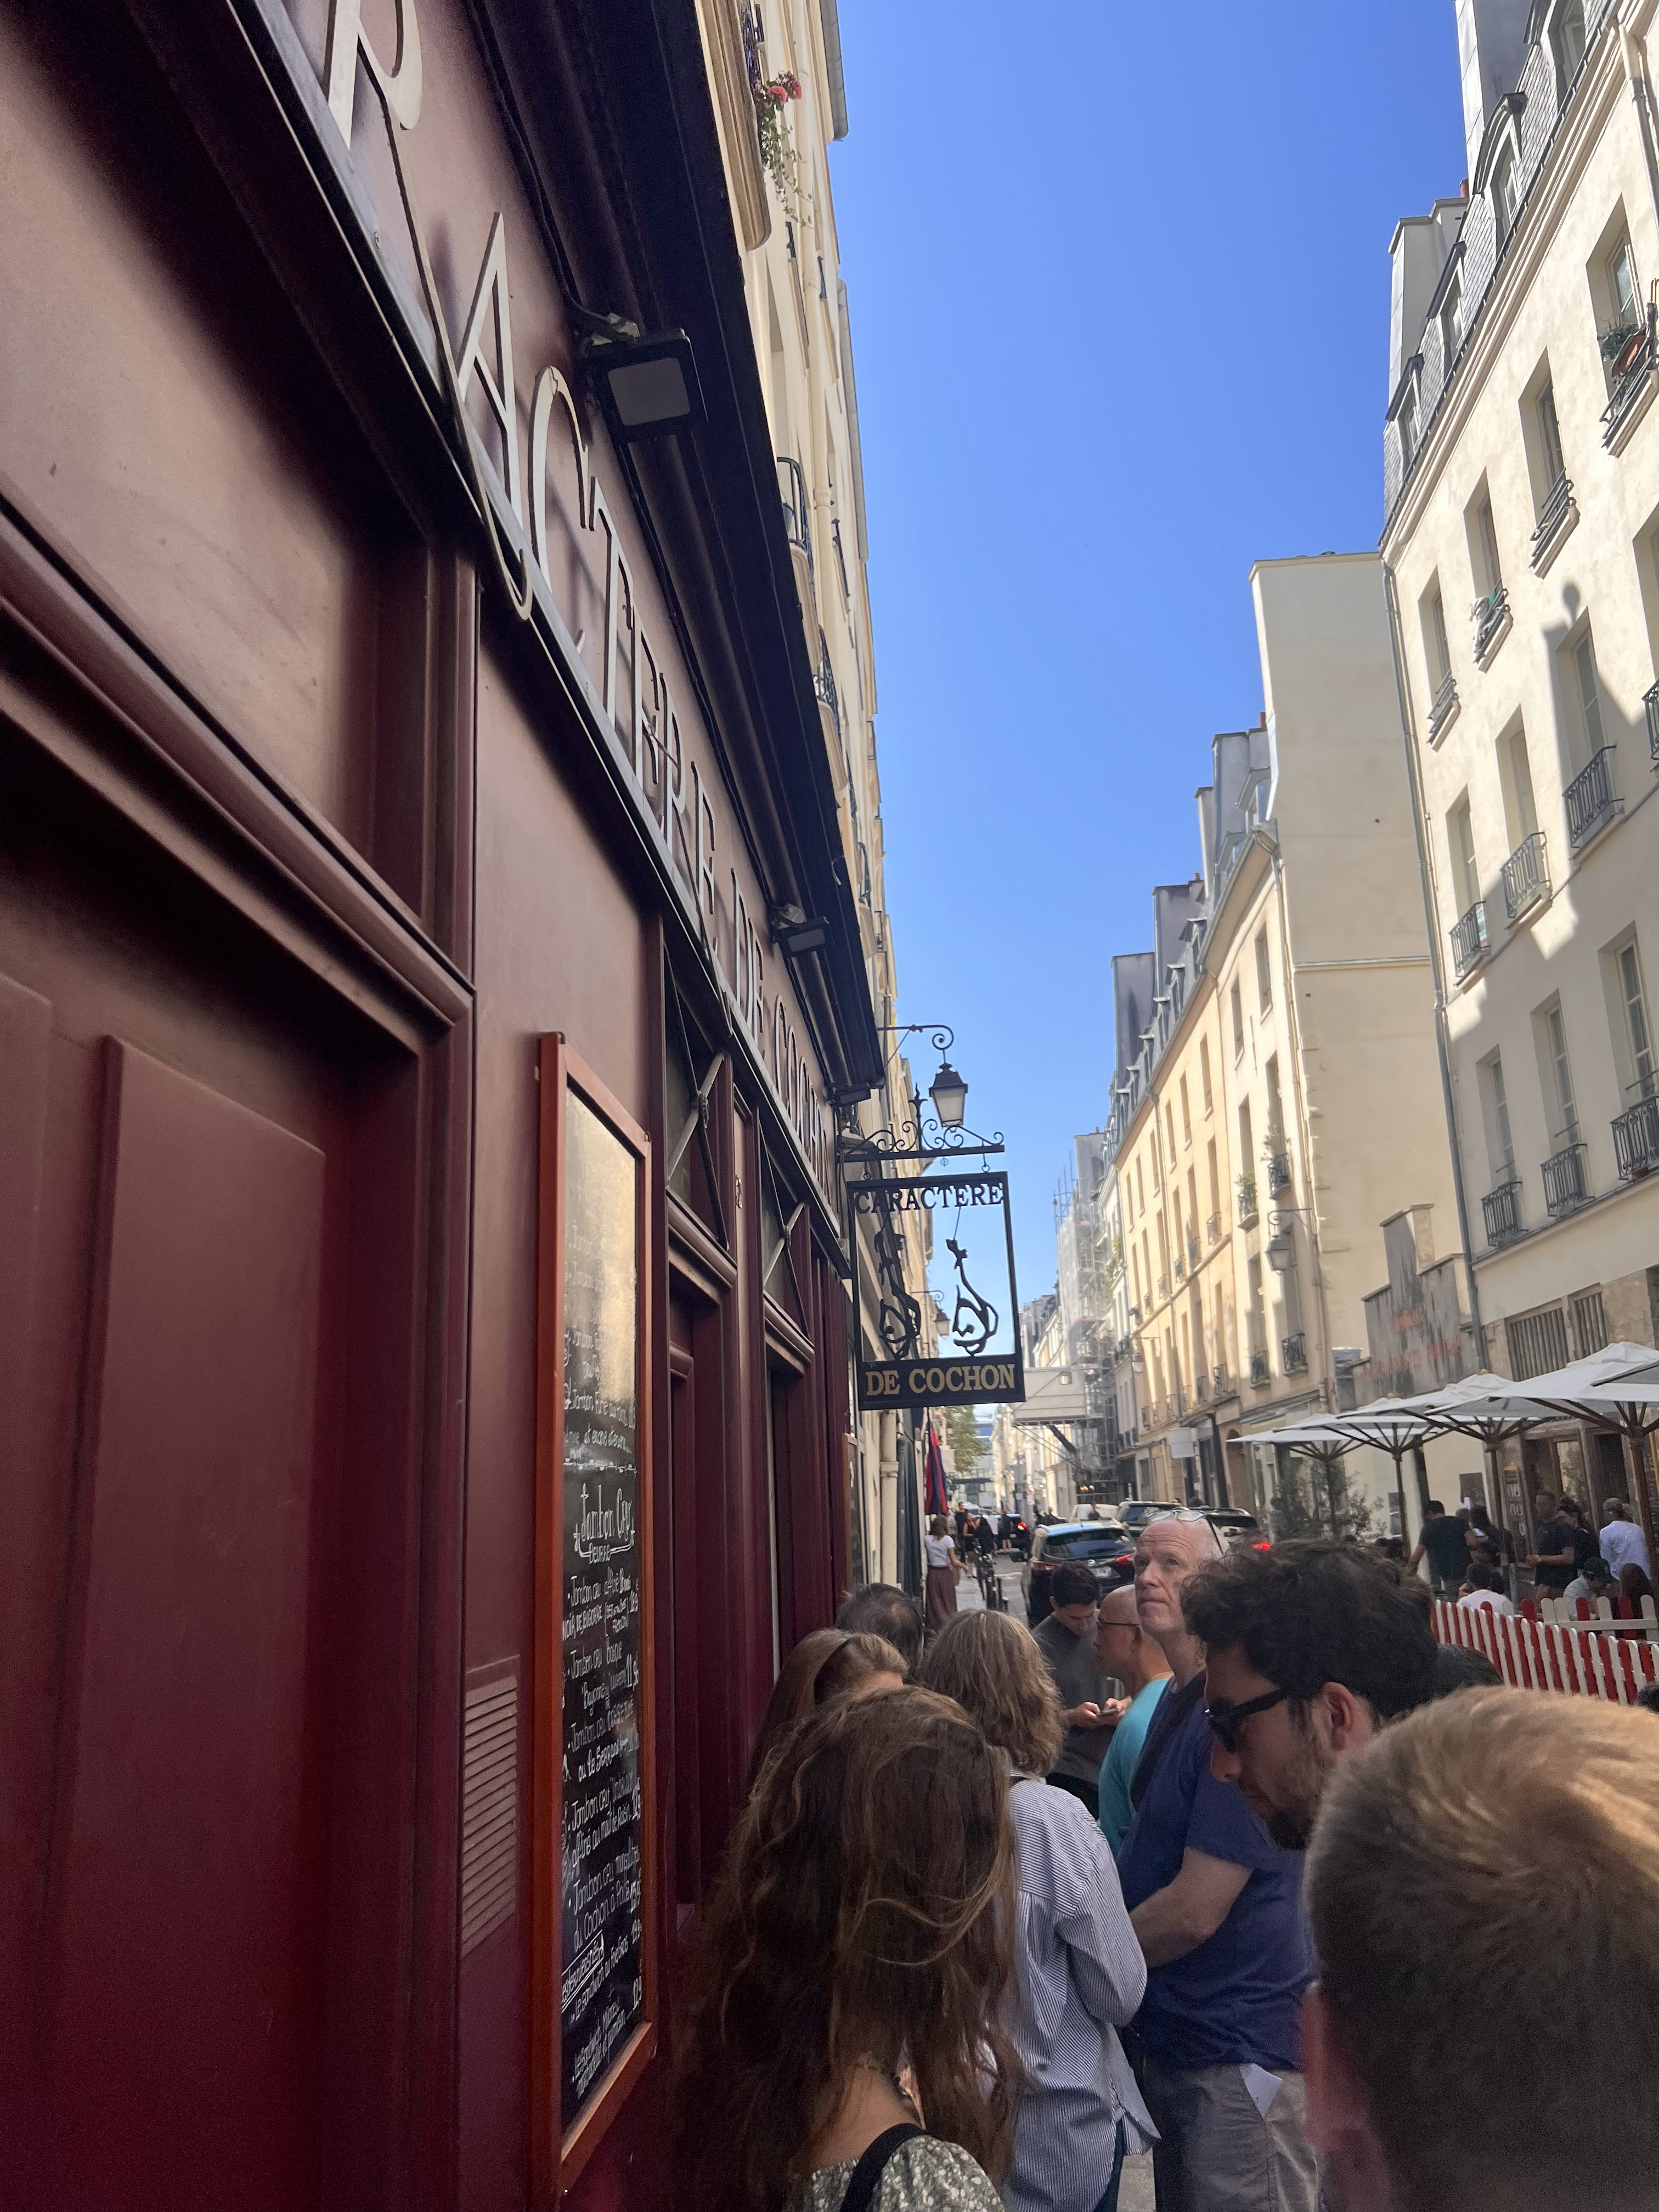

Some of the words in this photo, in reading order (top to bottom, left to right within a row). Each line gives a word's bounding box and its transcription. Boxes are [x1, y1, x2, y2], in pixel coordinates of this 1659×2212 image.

[730, 867, 766, 1063] DE
[866, 1370, 900, 1396] DE
[909, 1364, 1015, 1393] COCHON
[580, 1483, 615, 1542] Jambon
[572, 1792, 599, 1831] Jambon
[573, 1872, 603, 1916] Jambon
